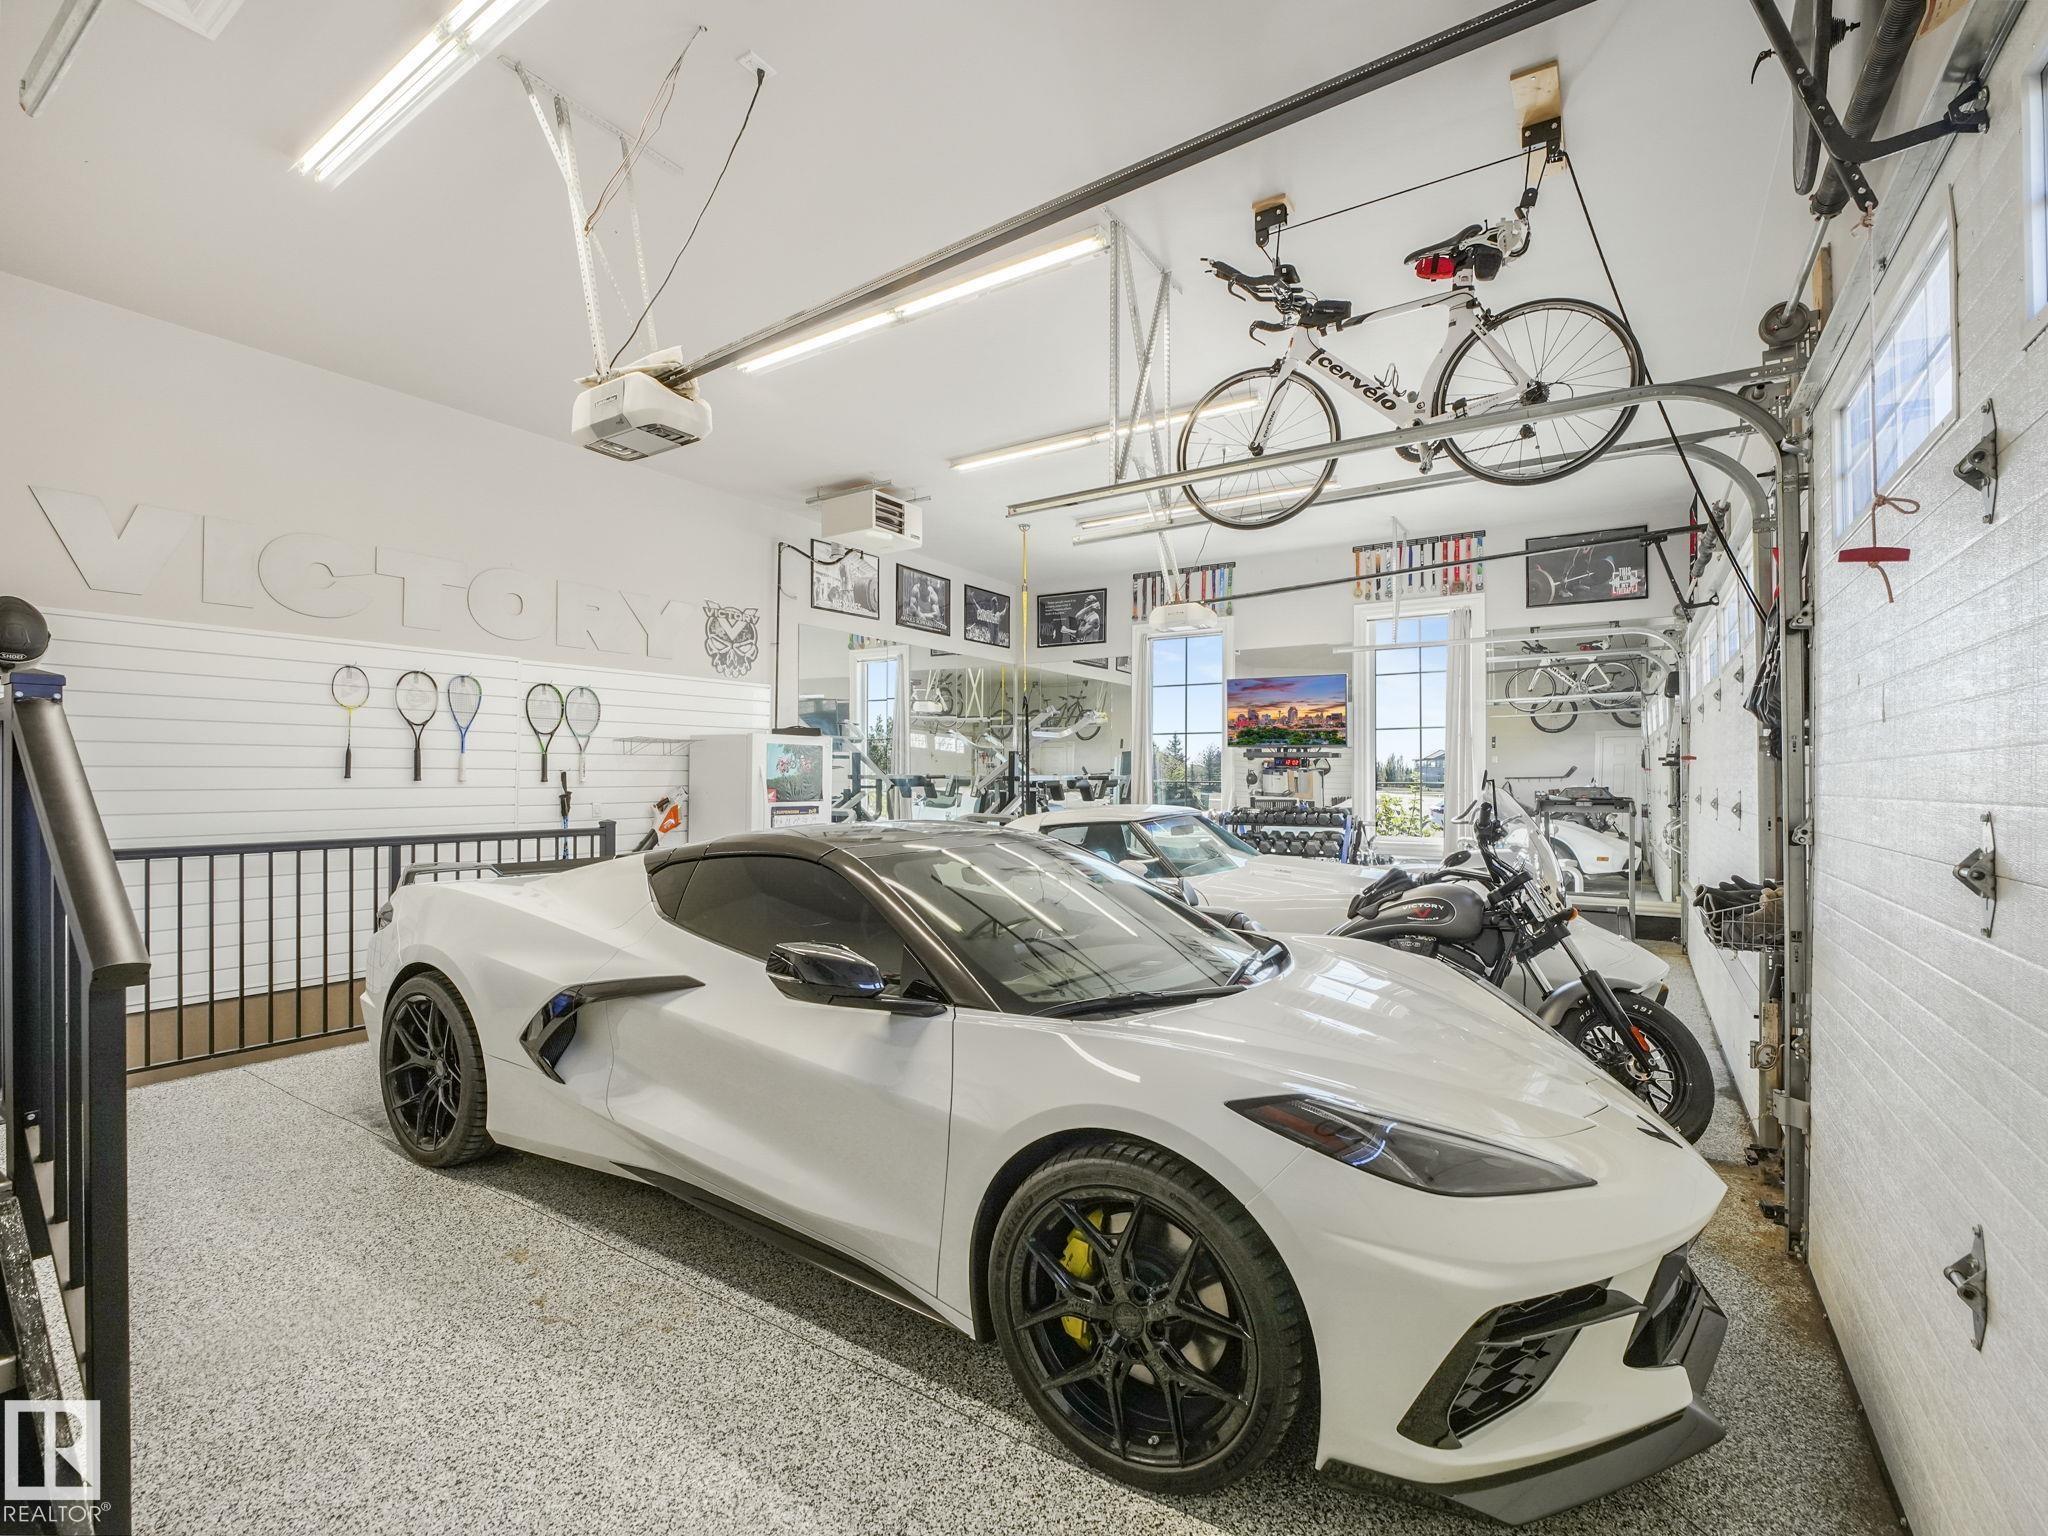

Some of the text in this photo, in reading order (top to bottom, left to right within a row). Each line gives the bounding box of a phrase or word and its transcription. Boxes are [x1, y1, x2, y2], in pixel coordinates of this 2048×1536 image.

[1317, 356, 1397, 411] cervélo
[28, 485, 697, 660] VICTORY
[1618, 566, 1632, 577] THIS
[702, 607, 760, 625] VICTORY
